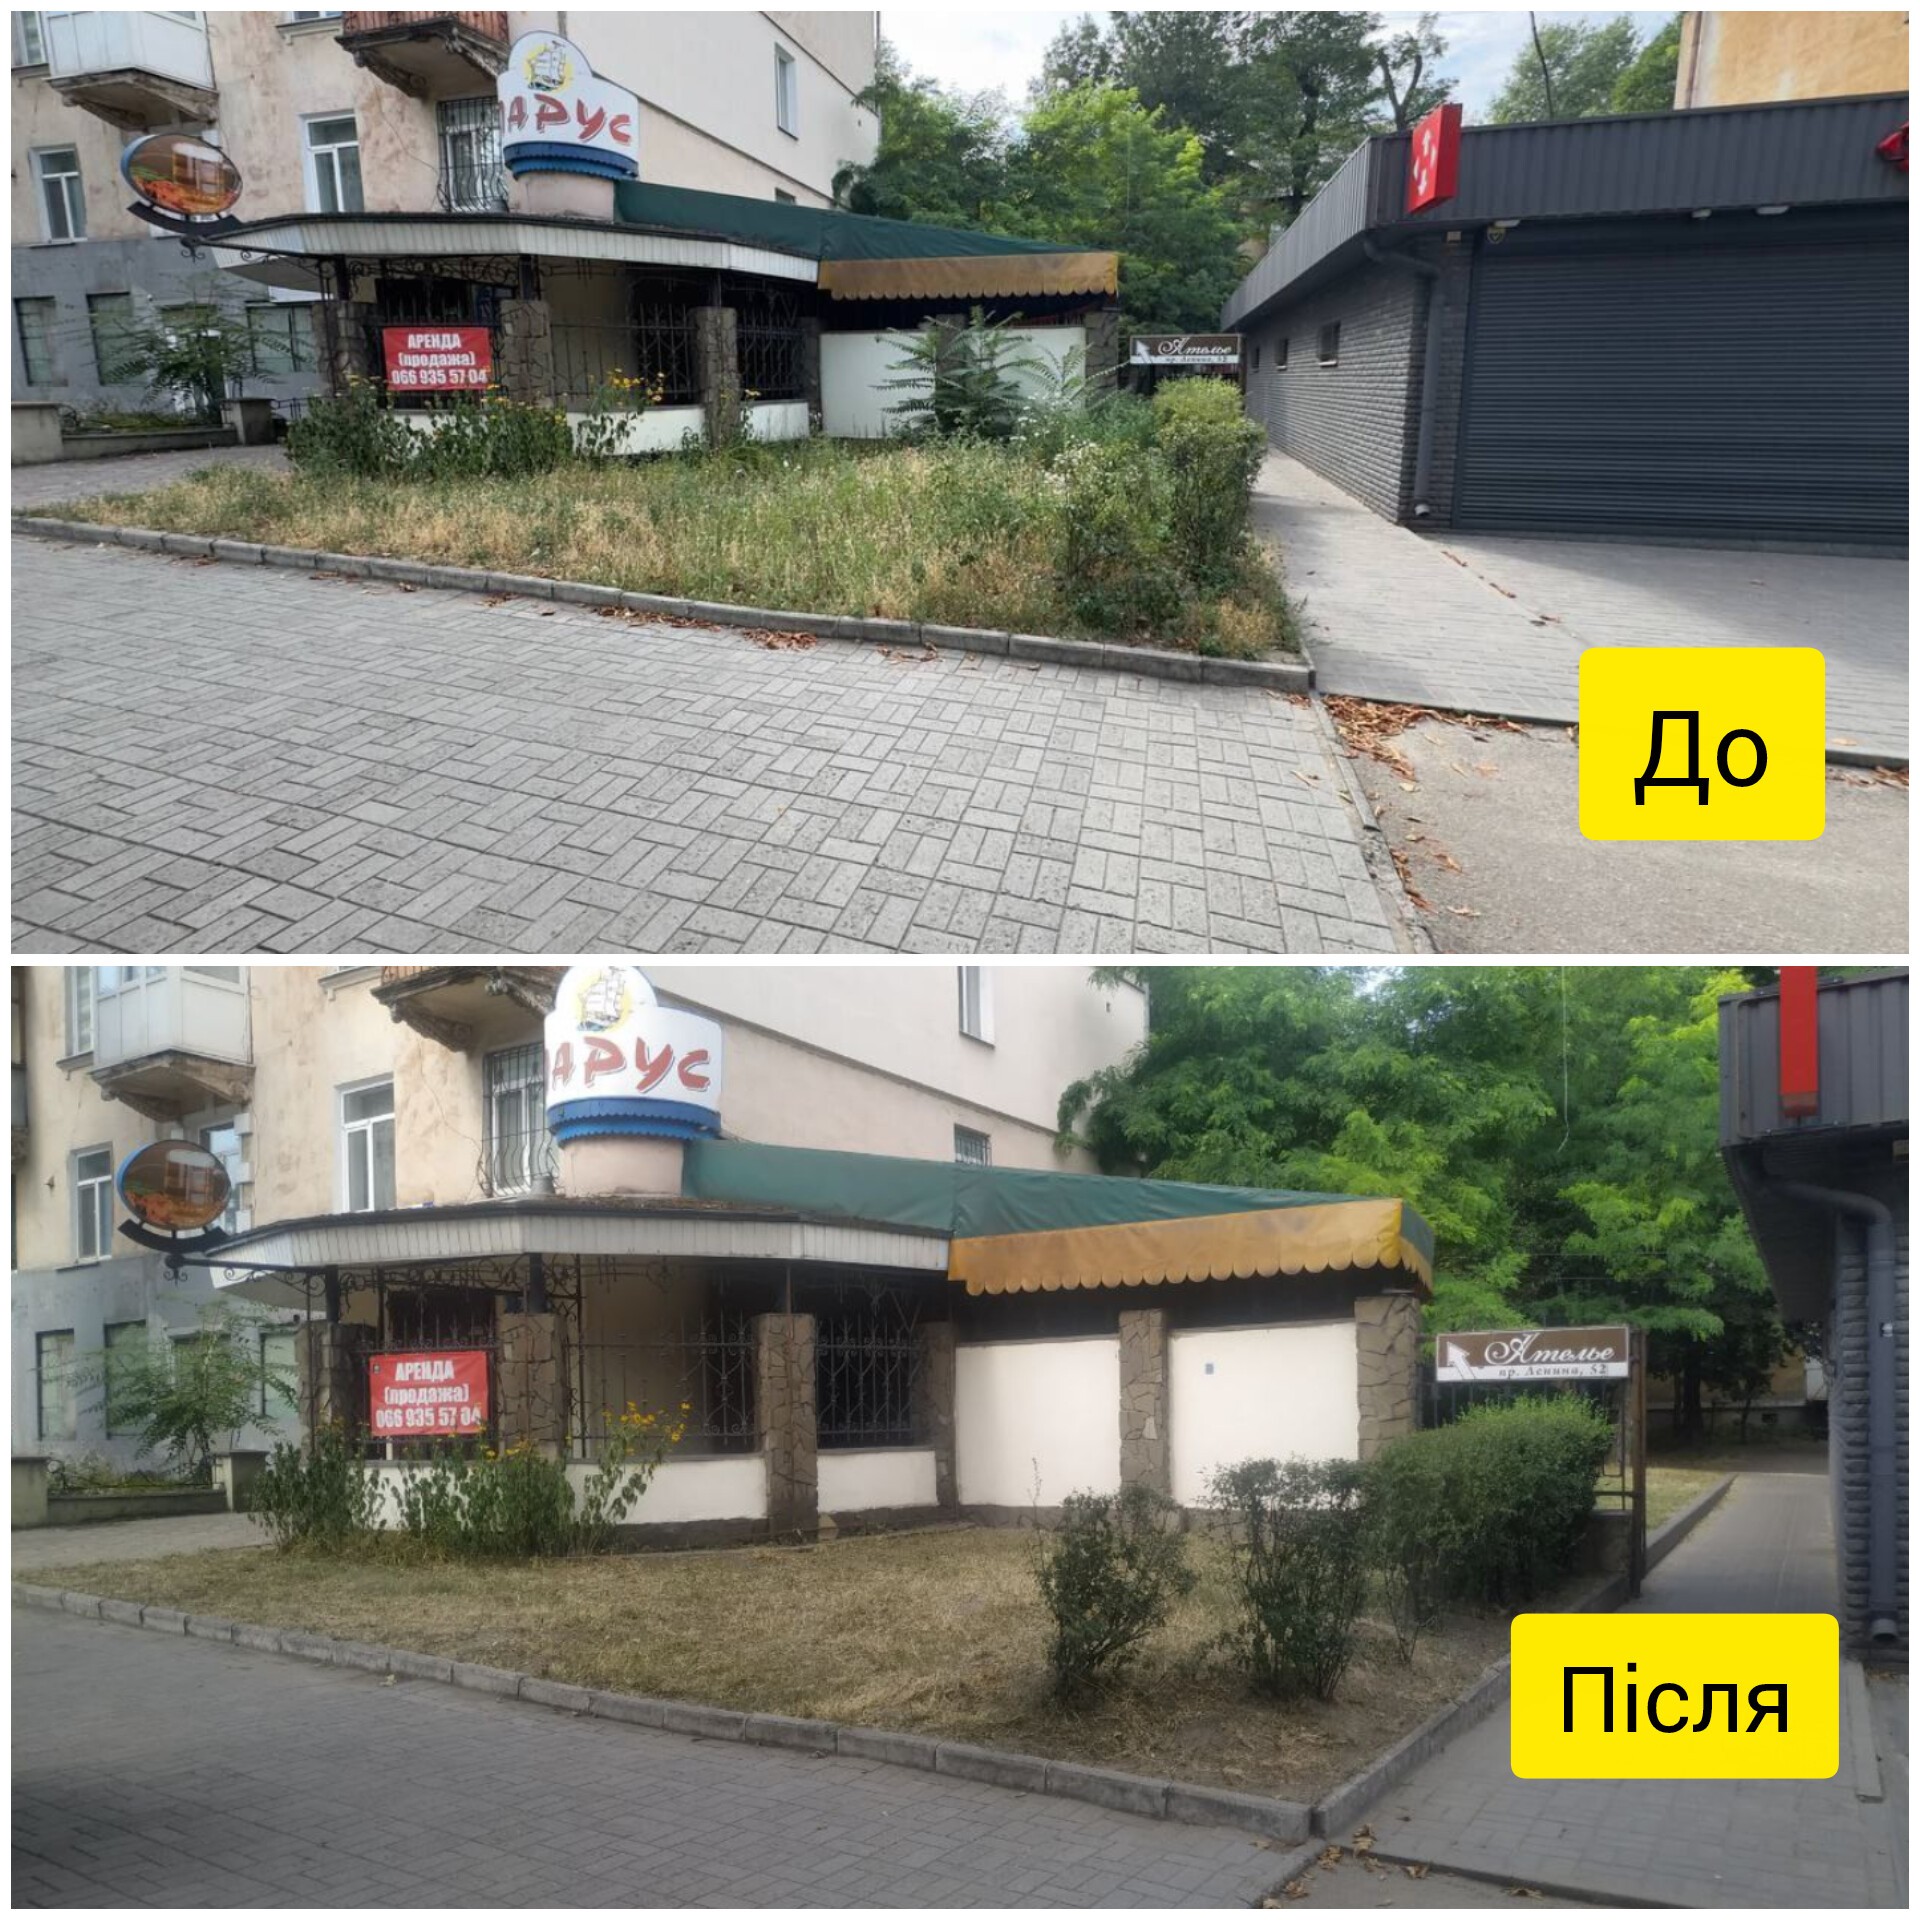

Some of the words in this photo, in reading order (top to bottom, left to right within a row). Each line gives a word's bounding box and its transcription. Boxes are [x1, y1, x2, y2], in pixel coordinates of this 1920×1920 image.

[408, 333, 461, 350] АРЕНДА
[1158, 337, 1232, 355] Ателье
[398, 351, 475, 367] (продажа)
[391, 369, 417, 384] 066
[420, 369, 446, 384] 935
[449, 369, 465, 384] 57
[468, 368, 488, 383] 04
[545, 1036, 711, 1093] АРУС
[1484, 1332, 1615, 1365] Ателье
[395, 1360, 455, 1381] АРЕНДА
[384, 1383, 470, 1405] (продажа)
[375, 1409, 403, 1428] 066
[405, 1407, 435, 1427] 935
[438, 1406, 457, 1427] 57
